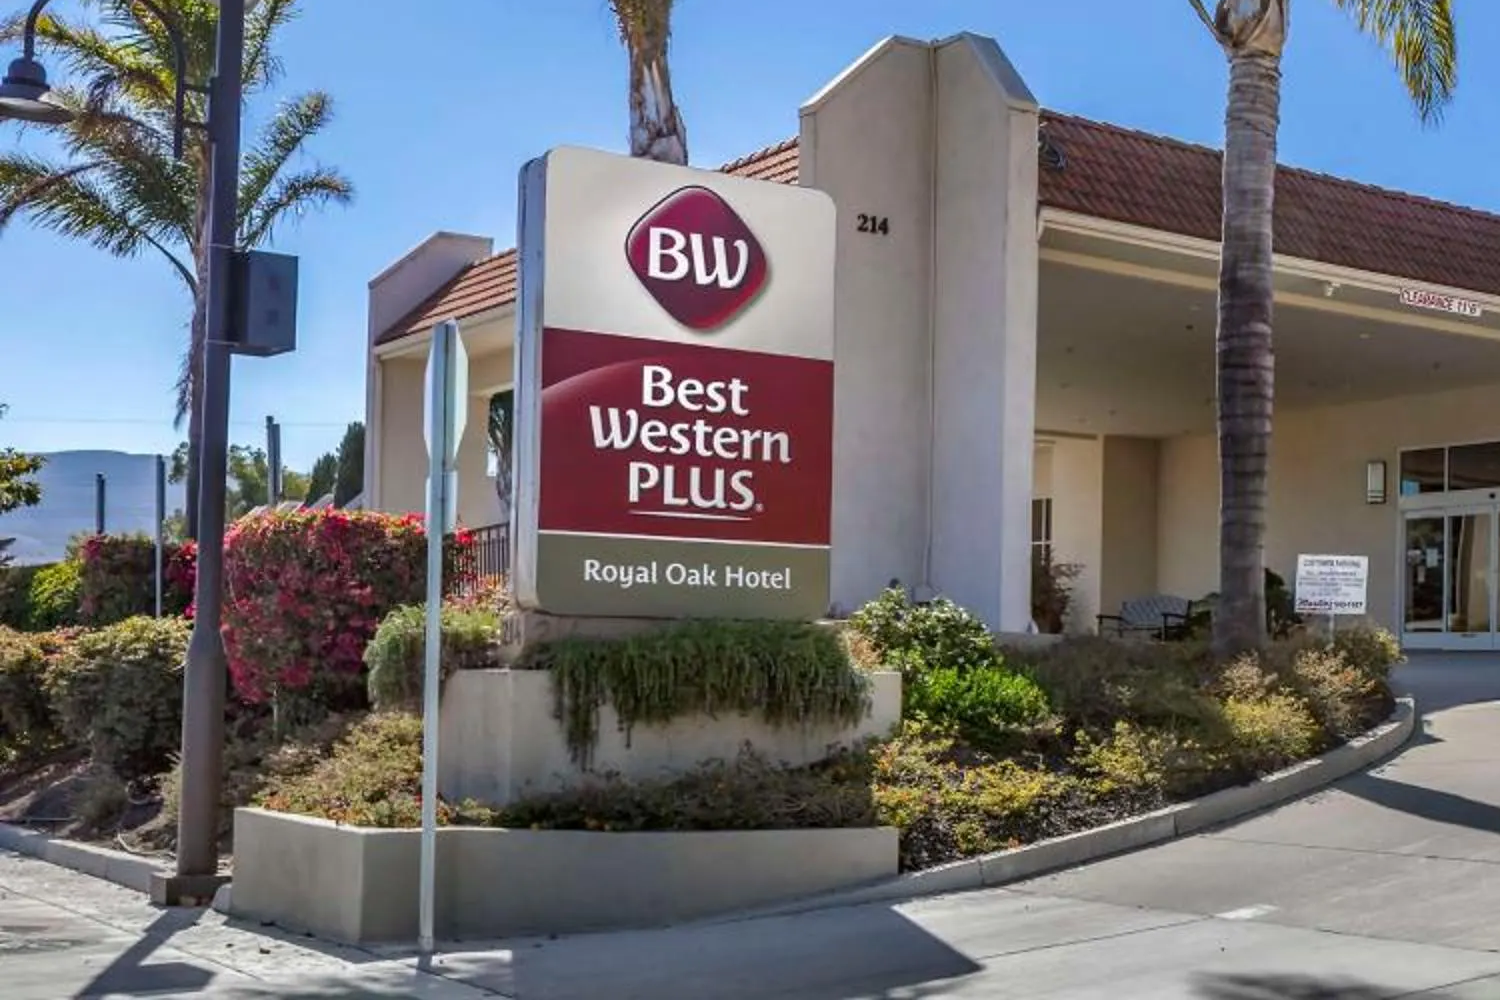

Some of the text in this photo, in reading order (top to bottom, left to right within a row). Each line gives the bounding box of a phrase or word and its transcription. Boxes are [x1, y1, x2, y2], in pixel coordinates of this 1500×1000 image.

[857, 213, 889, 236] 214
[648, 226, 749, 289] BW
[642, 365, 749, 415] Best
[590, 405, 791, 463] Western
[629, 462, 755, 511] PLUS
[584, 559, 791, 589] Royal Oak Hotel
